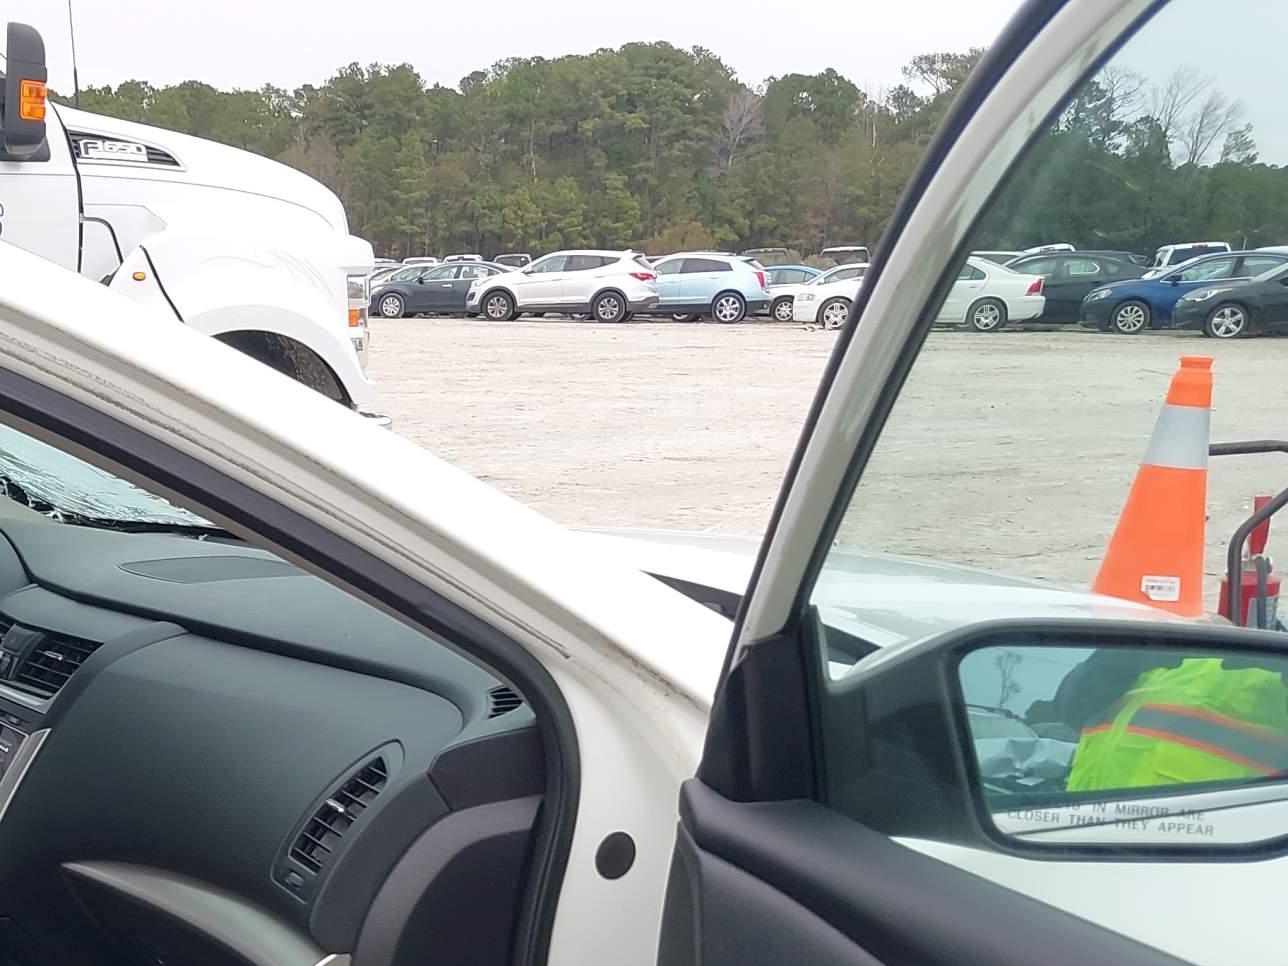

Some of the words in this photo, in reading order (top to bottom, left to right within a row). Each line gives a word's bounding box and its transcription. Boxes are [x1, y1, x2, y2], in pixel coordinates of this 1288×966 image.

[1114, 804, 1169, 816] MIRROR
[1007, 810, 1060, 823] CLOSER
[1158, 821, 1215, 836] APPEAR
